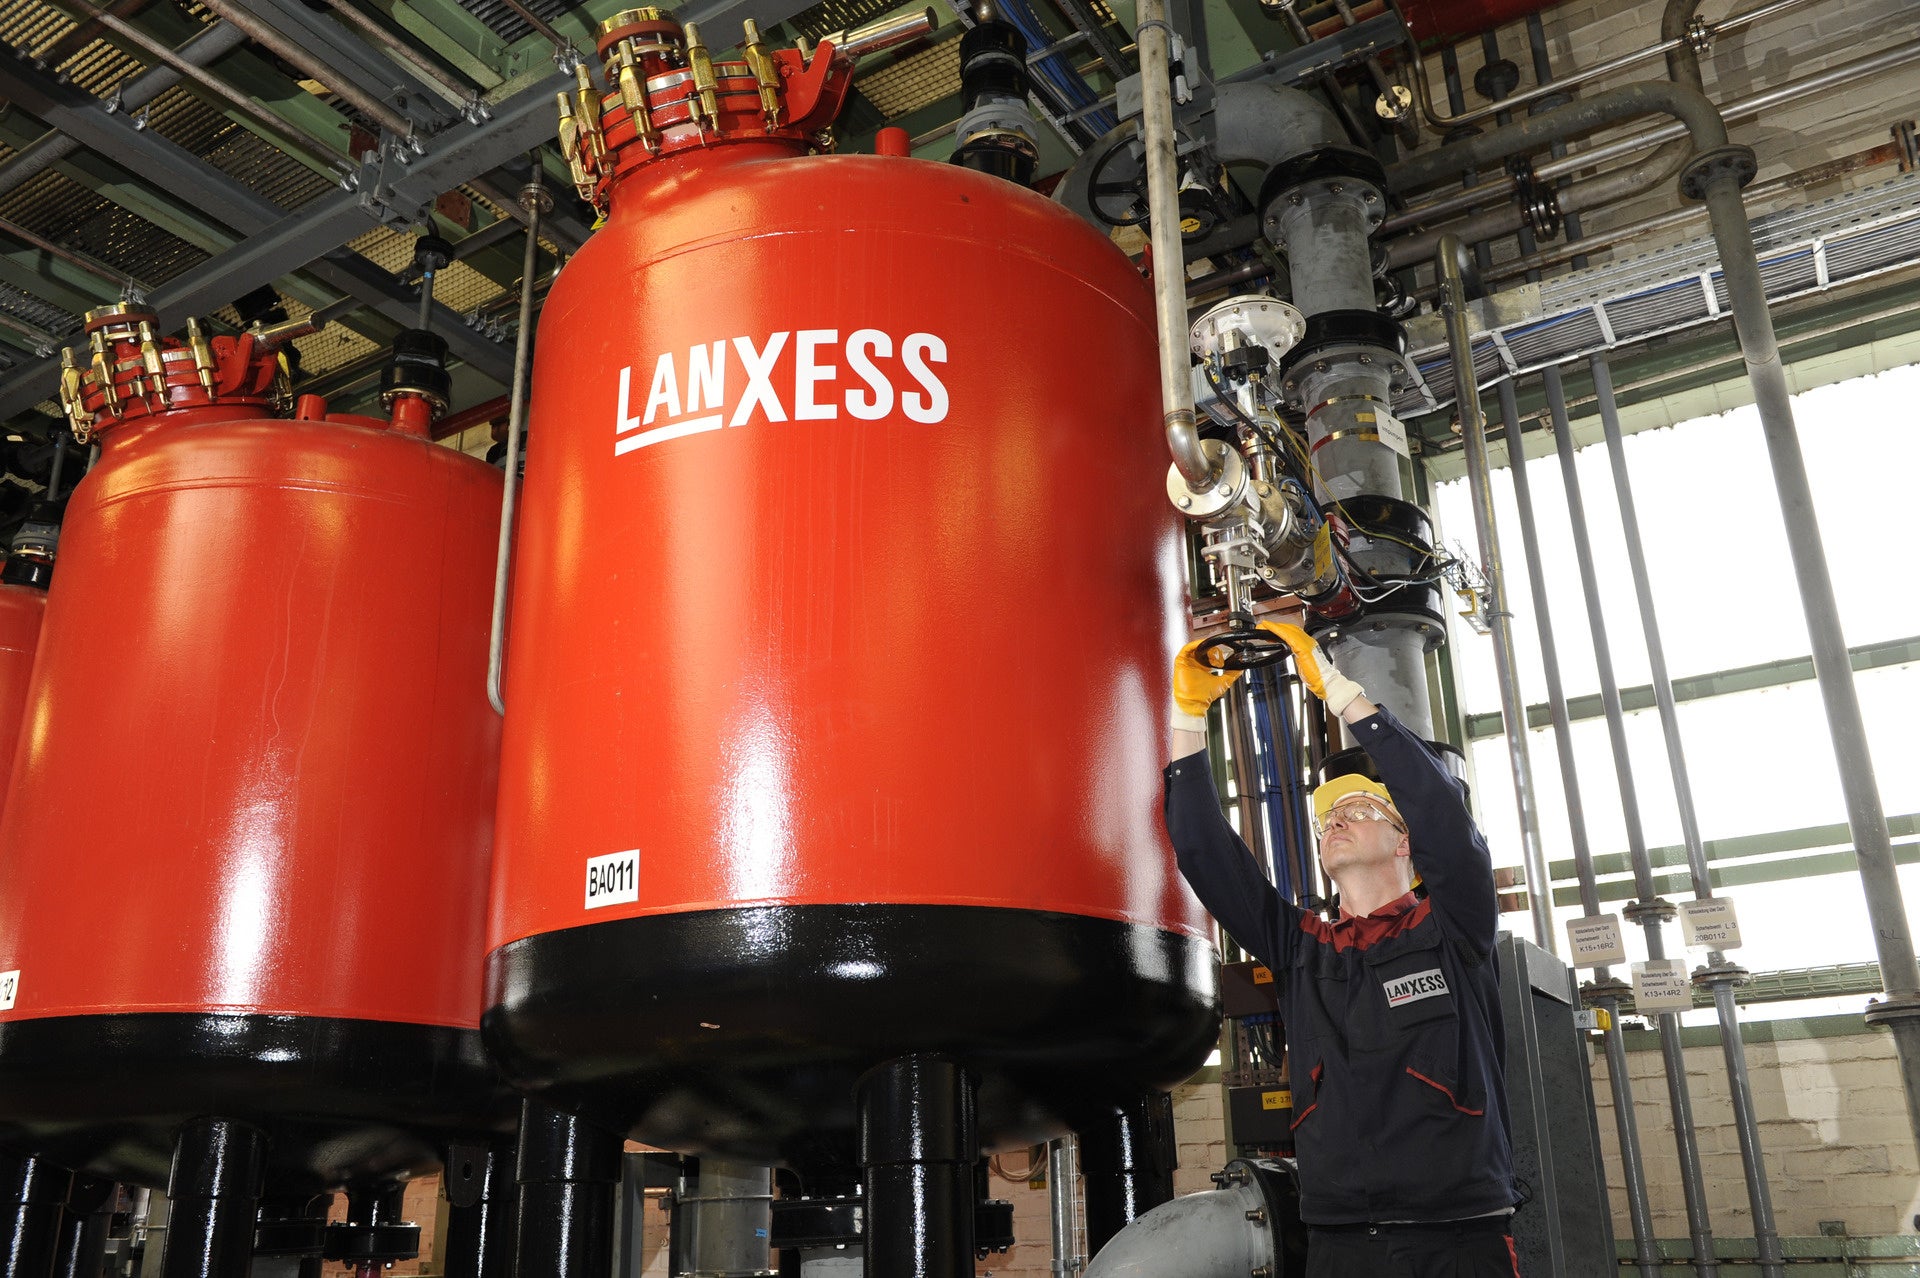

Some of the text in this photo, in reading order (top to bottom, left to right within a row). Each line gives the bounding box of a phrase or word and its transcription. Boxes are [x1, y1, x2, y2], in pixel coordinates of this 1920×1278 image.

[616, 329, 949, 435] LANXESS
[589, 859, 633, 897] BA011
[0, 977, 13, 1001] 12
[1387, 974, 1445, 999] LANXESS
